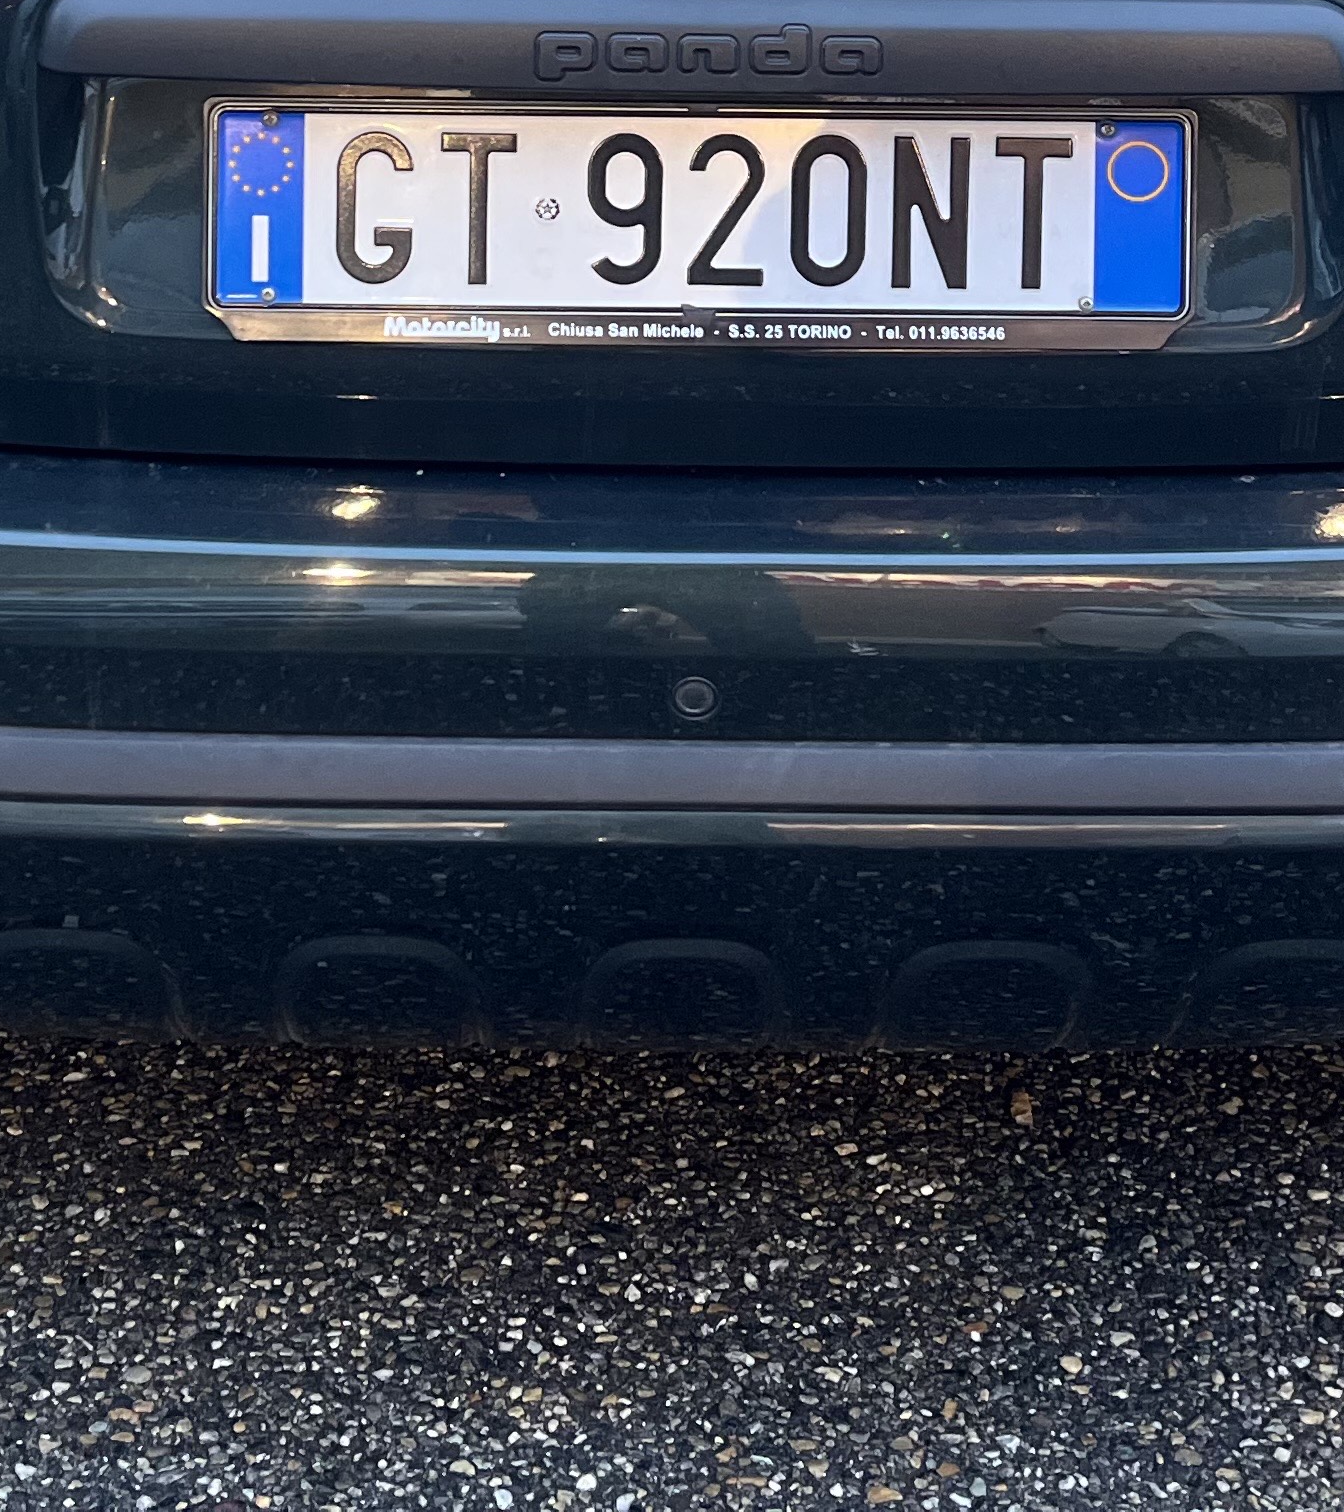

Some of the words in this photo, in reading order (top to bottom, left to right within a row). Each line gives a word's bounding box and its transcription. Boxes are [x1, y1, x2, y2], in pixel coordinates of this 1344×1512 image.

[533, 23, 885, 82] panda
[336, 131, 518, 286] GT
[587, 132, 1074, 290] 920NT
[384, 315, 501, 342] Motorcity
[503, 325, 532, 338] s.r.l.
[548, 322, 604, 338] Chiusa
[607, 322, 638, 338] San
[642, 322, 705, 339] Michele
[728, 323, 761, 339] S.S.
[764, 324, 784, 339] 25
[788, 324, 852, 340] TORINO
[875, 325, 904, 340] Tel.
[909, 325, 1006, 341] 011.9636546
